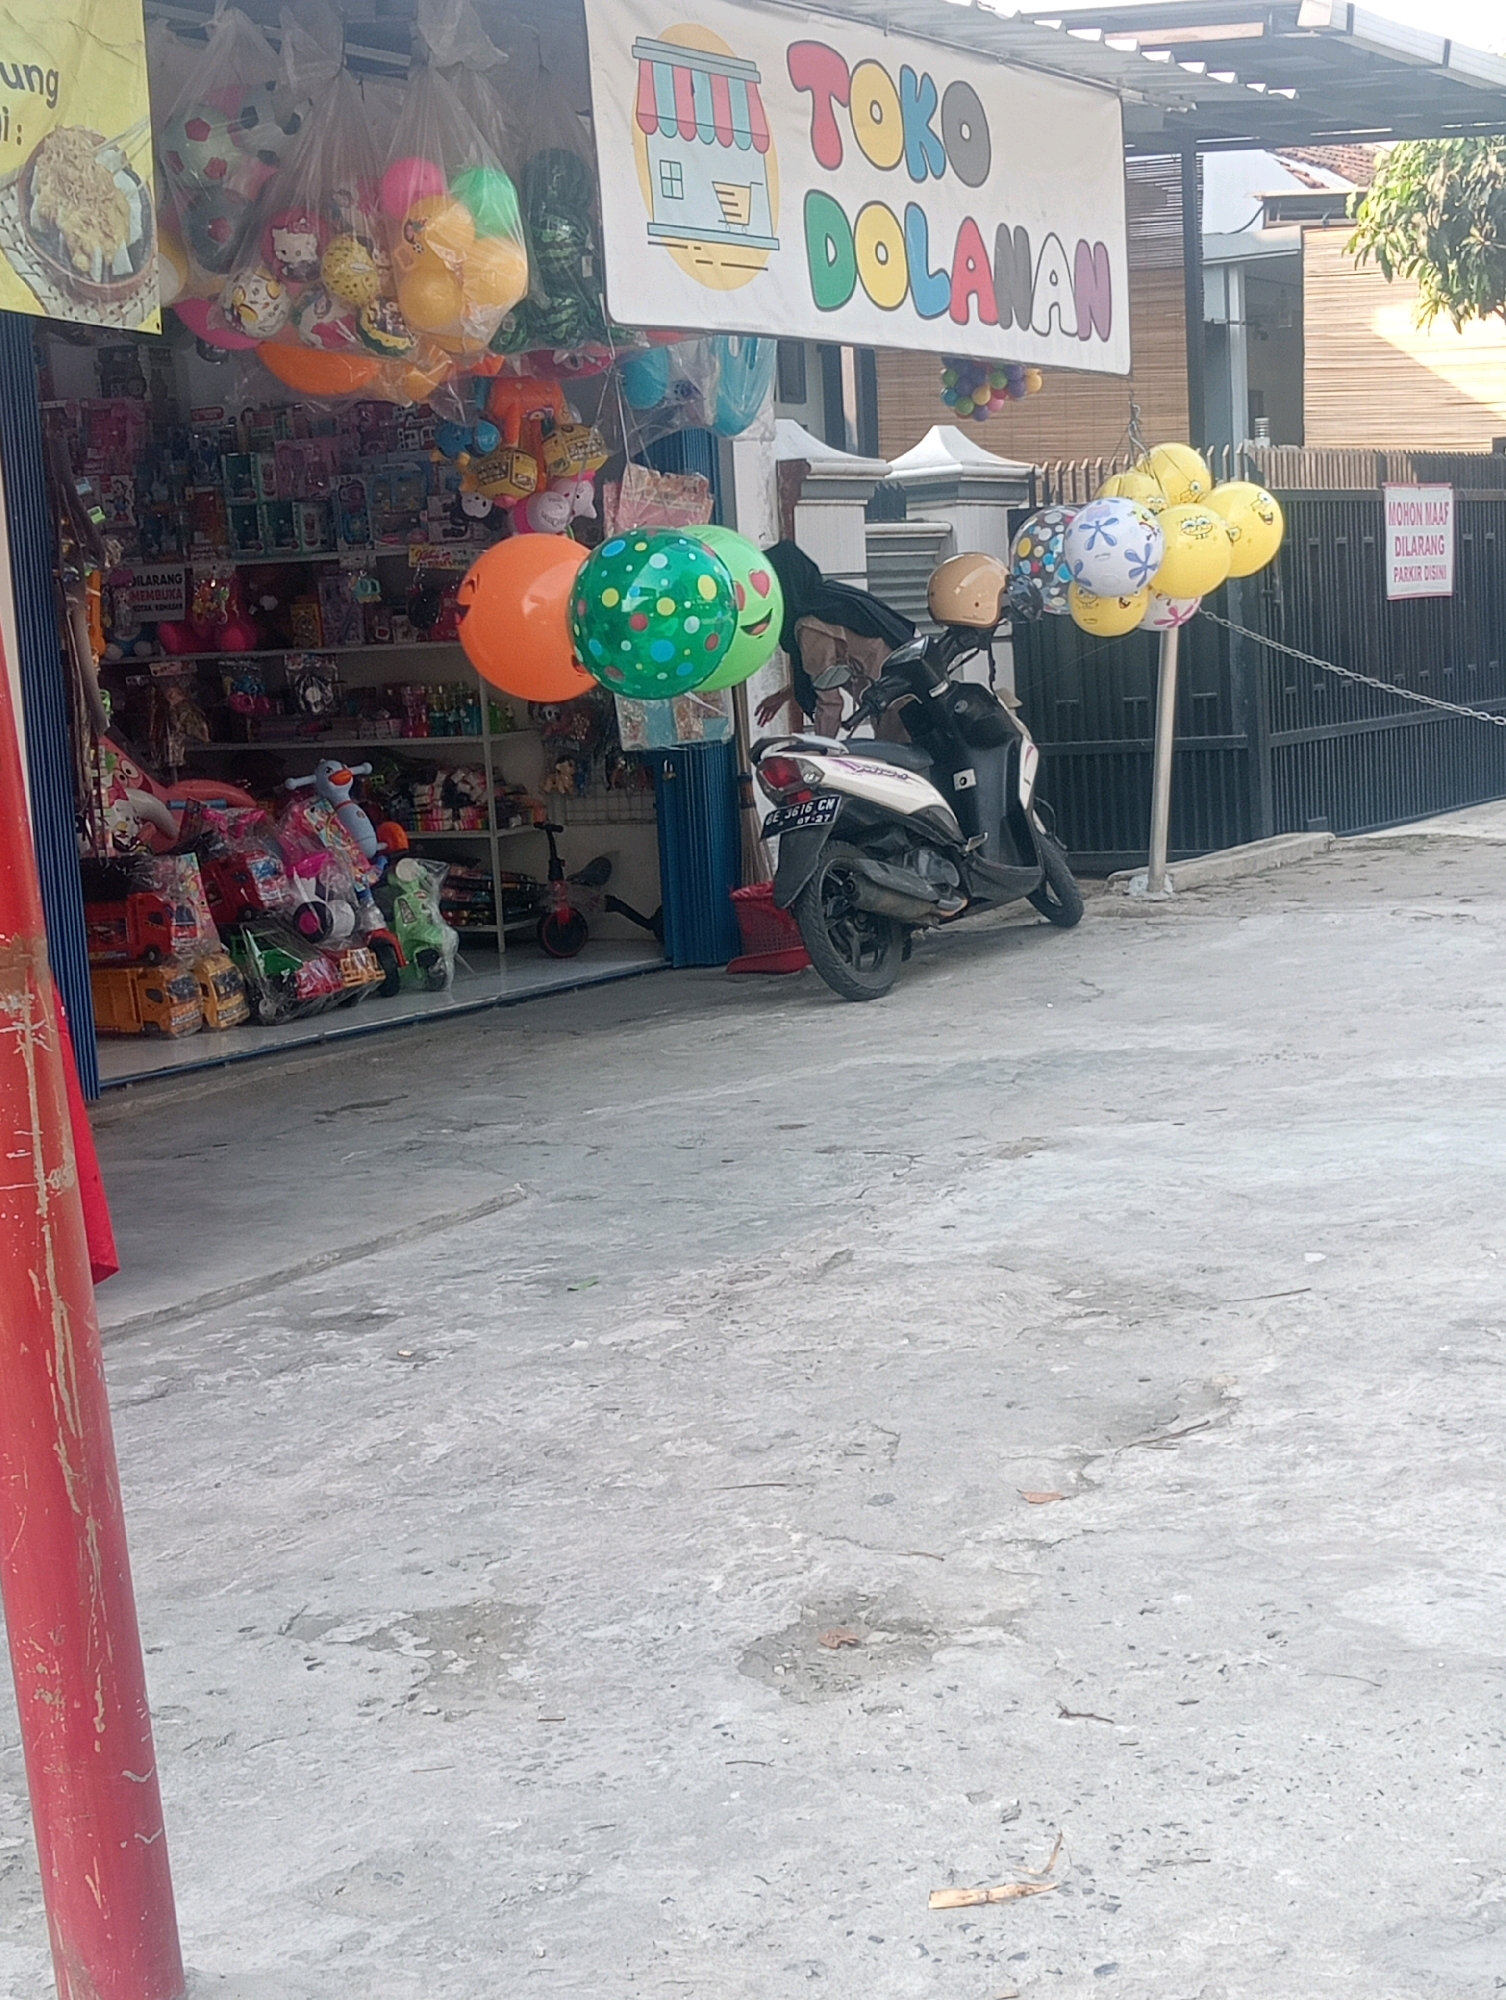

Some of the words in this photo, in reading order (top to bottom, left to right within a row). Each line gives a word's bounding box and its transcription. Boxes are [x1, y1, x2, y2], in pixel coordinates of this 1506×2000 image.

[787, 40, 991, 188] TOKO
[803, 188, 1112, 342] DOLANAN
[1388, 501, 1423, 526] MOHON
[1425, 501, 1449, 526] MAAF
[1394, 534, 1445, 557] DILARANG
[1393, 565, 1423, 583] PARKIR
[1424, 564, 1447, 581] DISINI
